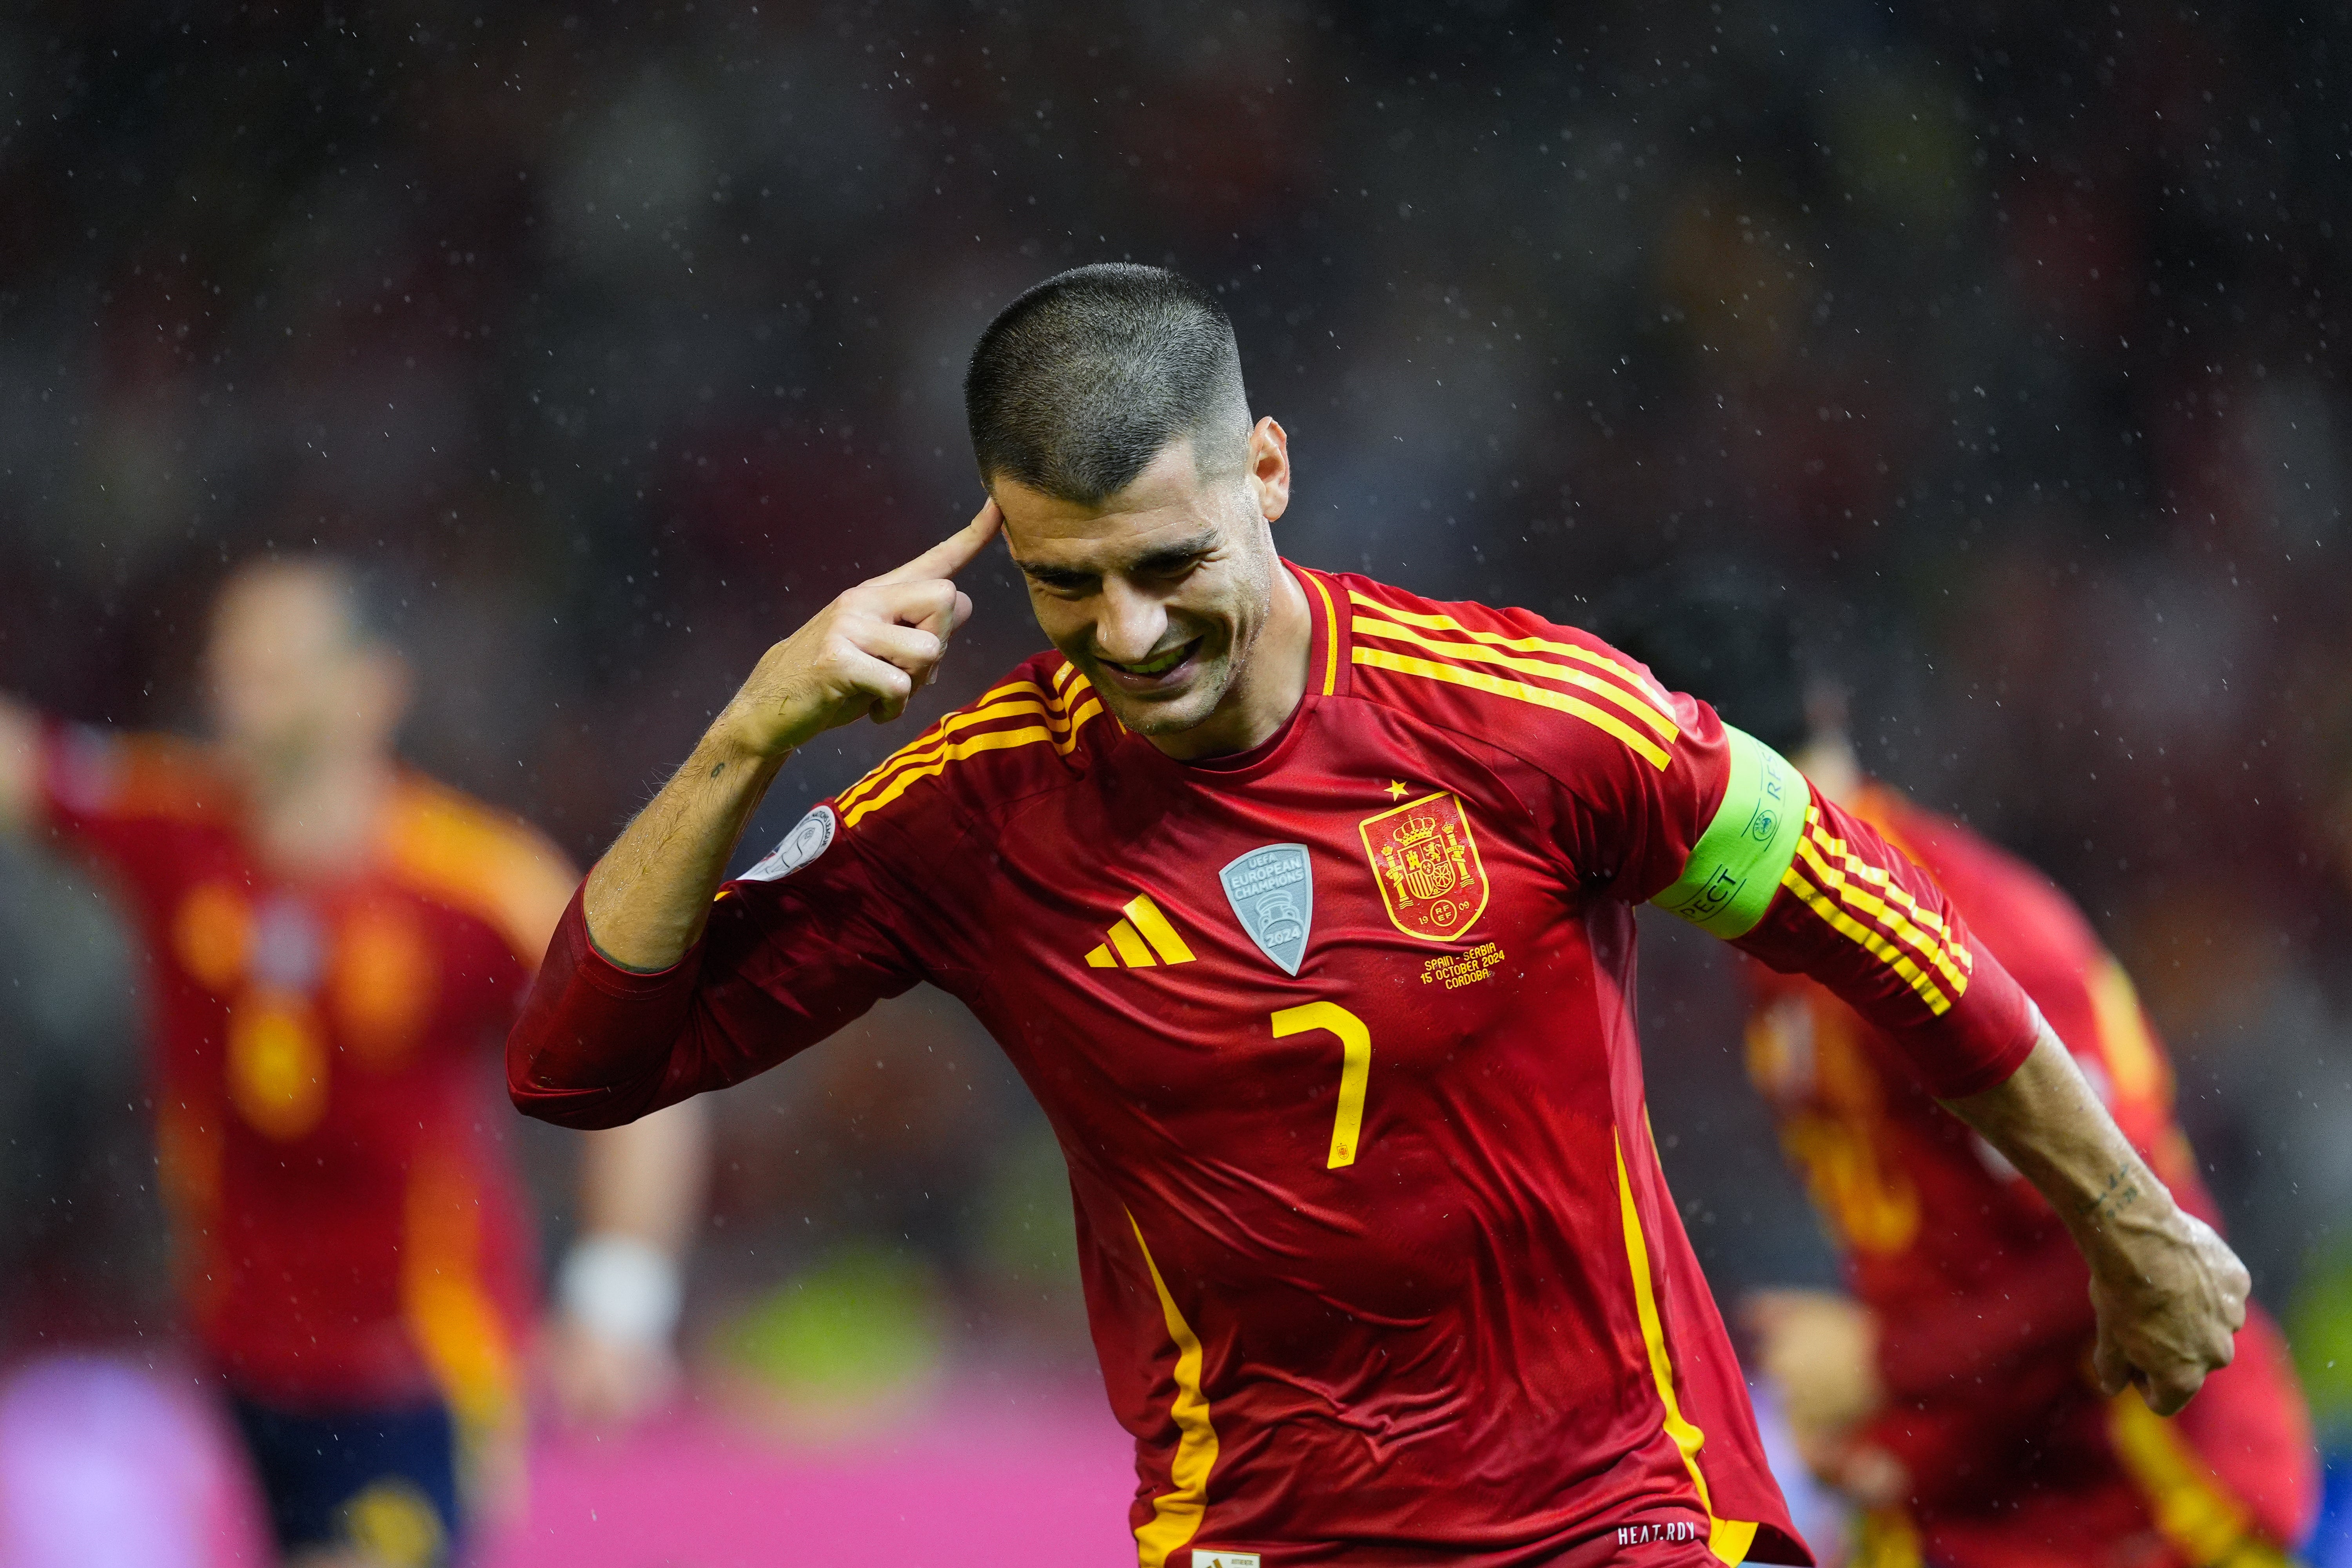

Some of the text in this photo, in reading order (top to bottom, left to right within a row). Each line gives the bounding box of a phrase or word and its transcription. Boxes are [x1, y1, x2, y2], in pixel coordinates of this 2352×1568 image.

[1231, 858, 1302, 889] EUROPEAN
[1248, 853, 1278, 869] UEFA
[1235, 869, 1305, 900] CHAMPIONS
[1418, 901, 1470, 925] 19 09
[1264, 926, 1302, 948] 2024
[1420, 950, 1505, 984] 15 OCTOBER 2024
[1424, 955, 1454, 971] SPAIN
[1463, 942, 1496, 961] SERBIA
[1445, 968, 1489, 989] CORDOBA
[1270, 1001, 1371, 1169] 7
[1618, 1522, 1695, 1545] HEAT.RDY
